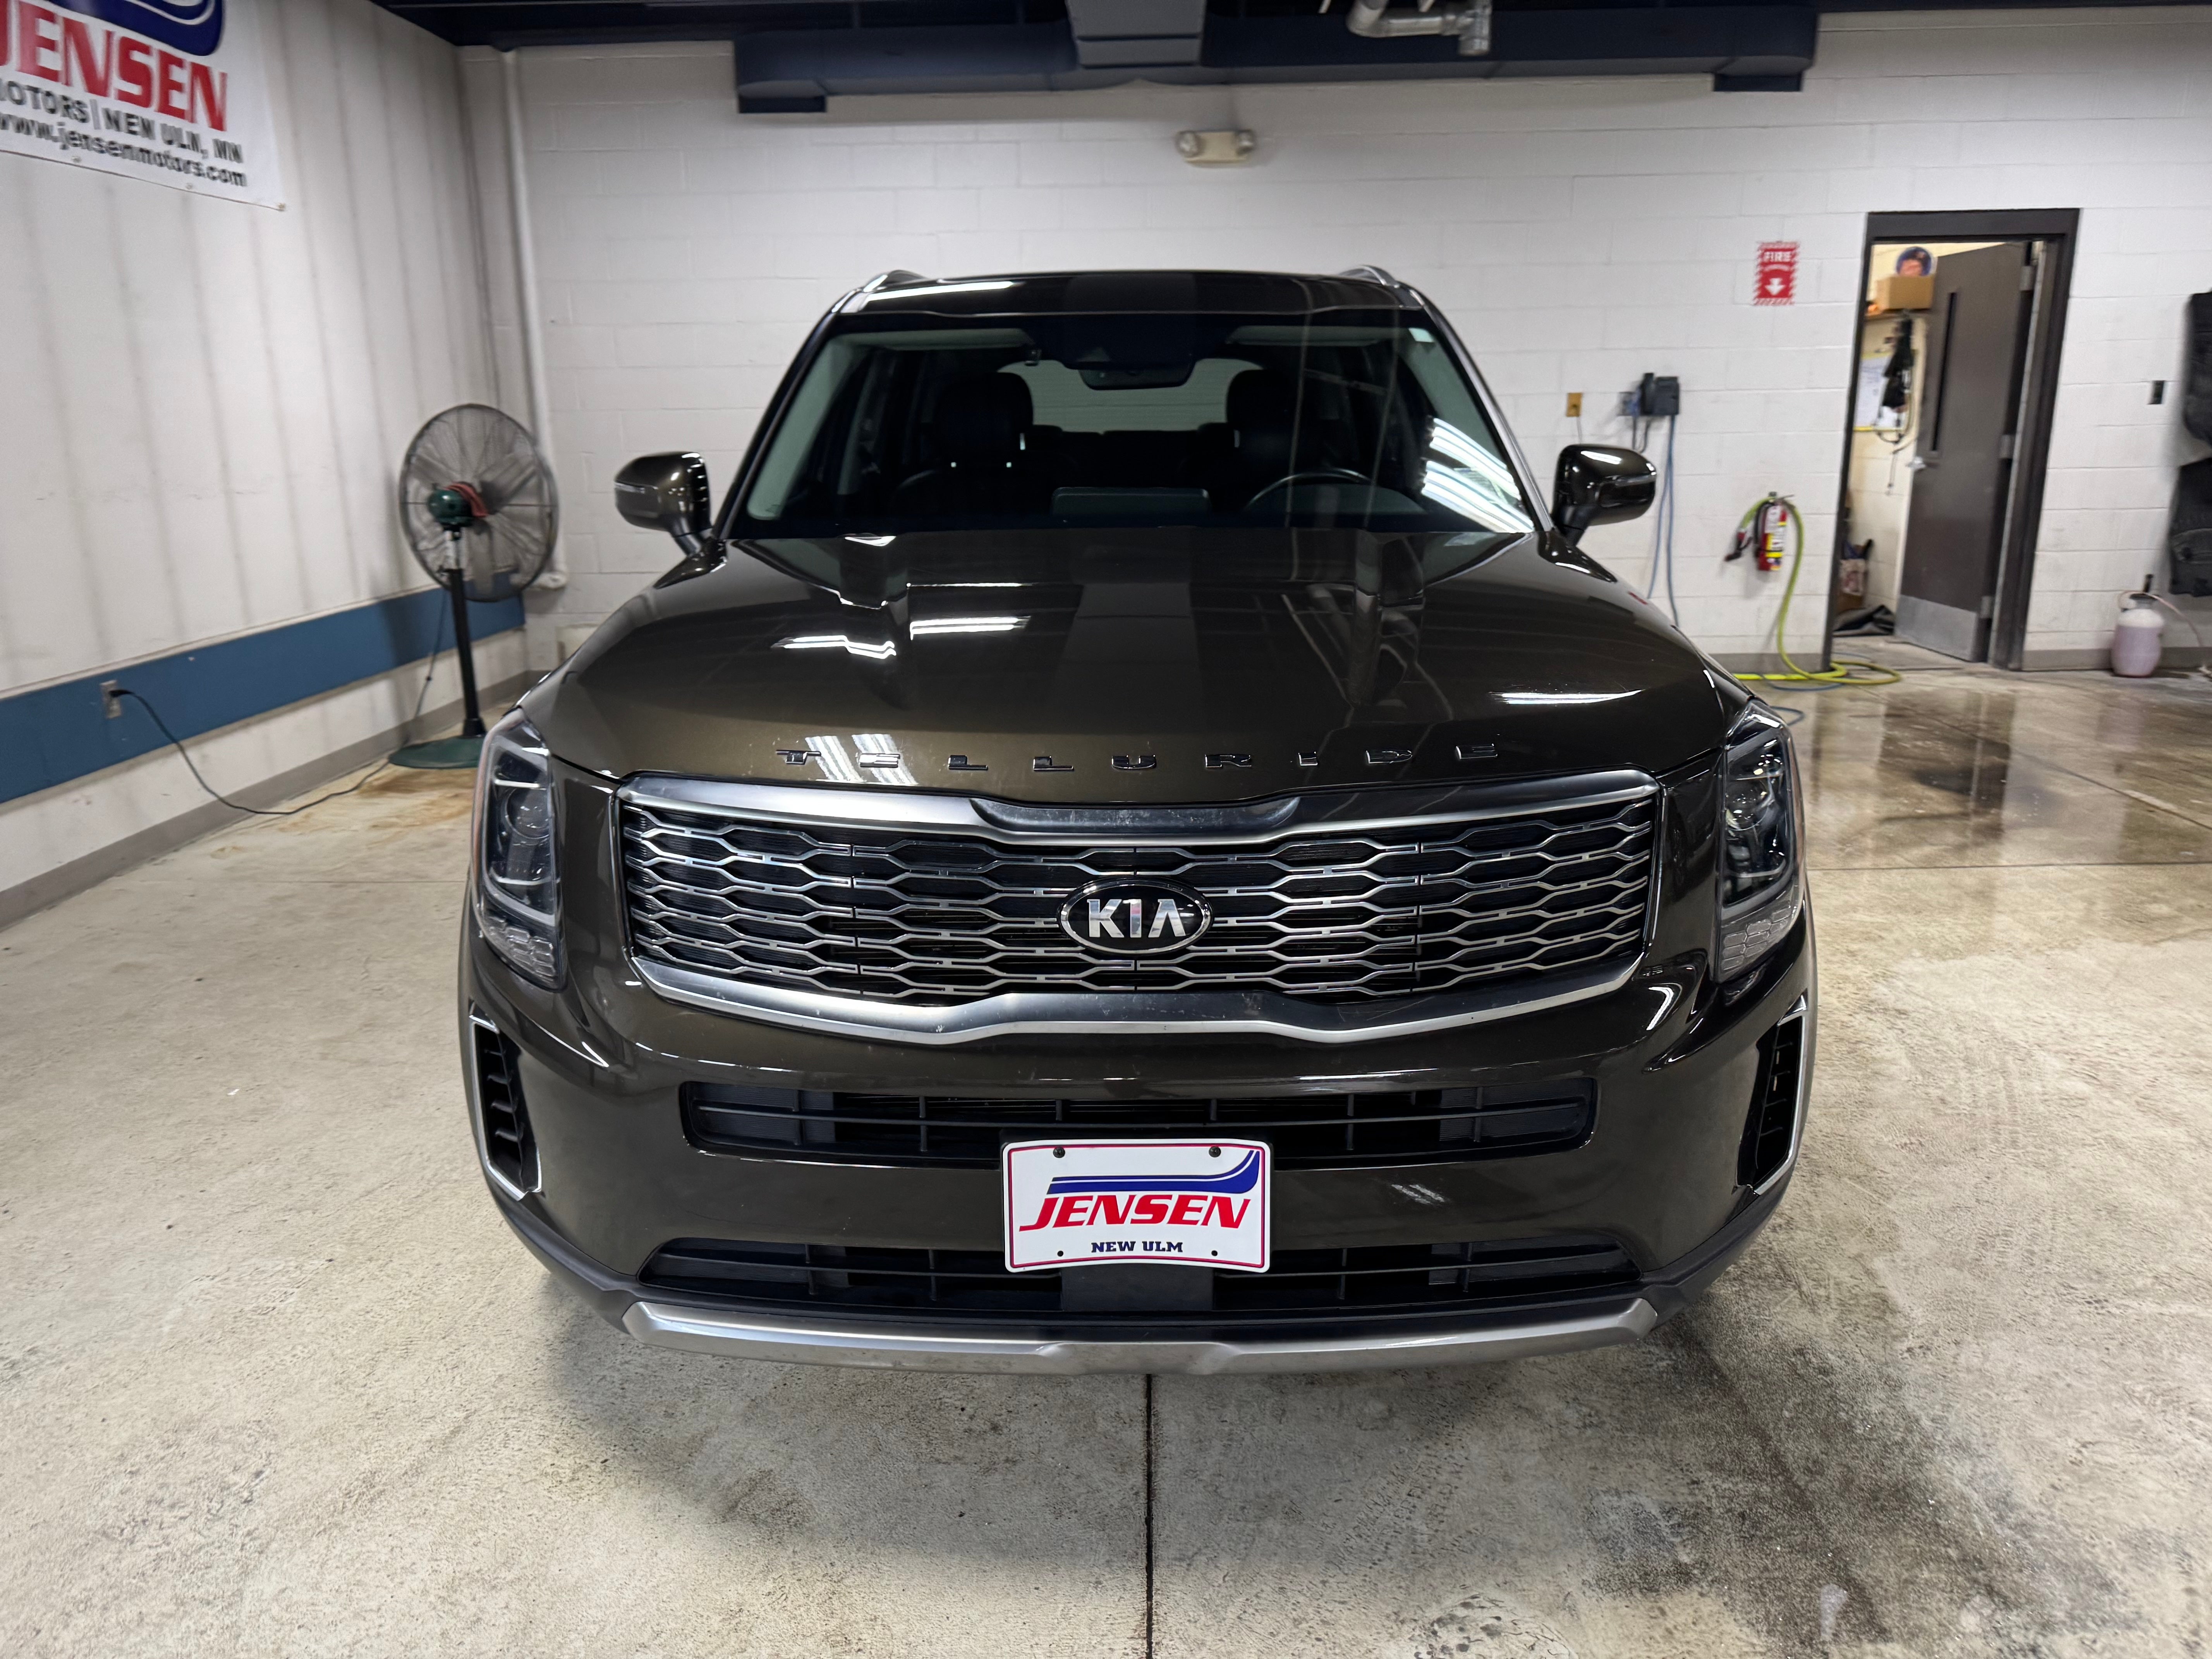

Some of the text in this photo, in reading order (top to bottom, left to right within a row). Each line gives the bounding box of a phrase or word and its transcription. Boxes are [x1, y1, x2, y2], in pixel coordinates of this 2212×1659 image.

[0, 78, 91, 123] OTORS
[102, 107, 155, 140] NEW
[212, 139, 244, 163] MN
[1763, 251, 1792, 262] FIRE
[776, 743, 1498, 771] TELLURIDE
[1087, 899, 1186, 938] KIA
[1018, 1195, 1251, 1232] JENSEN
[1091, 1241, 1183, 1253] NEW ULM
